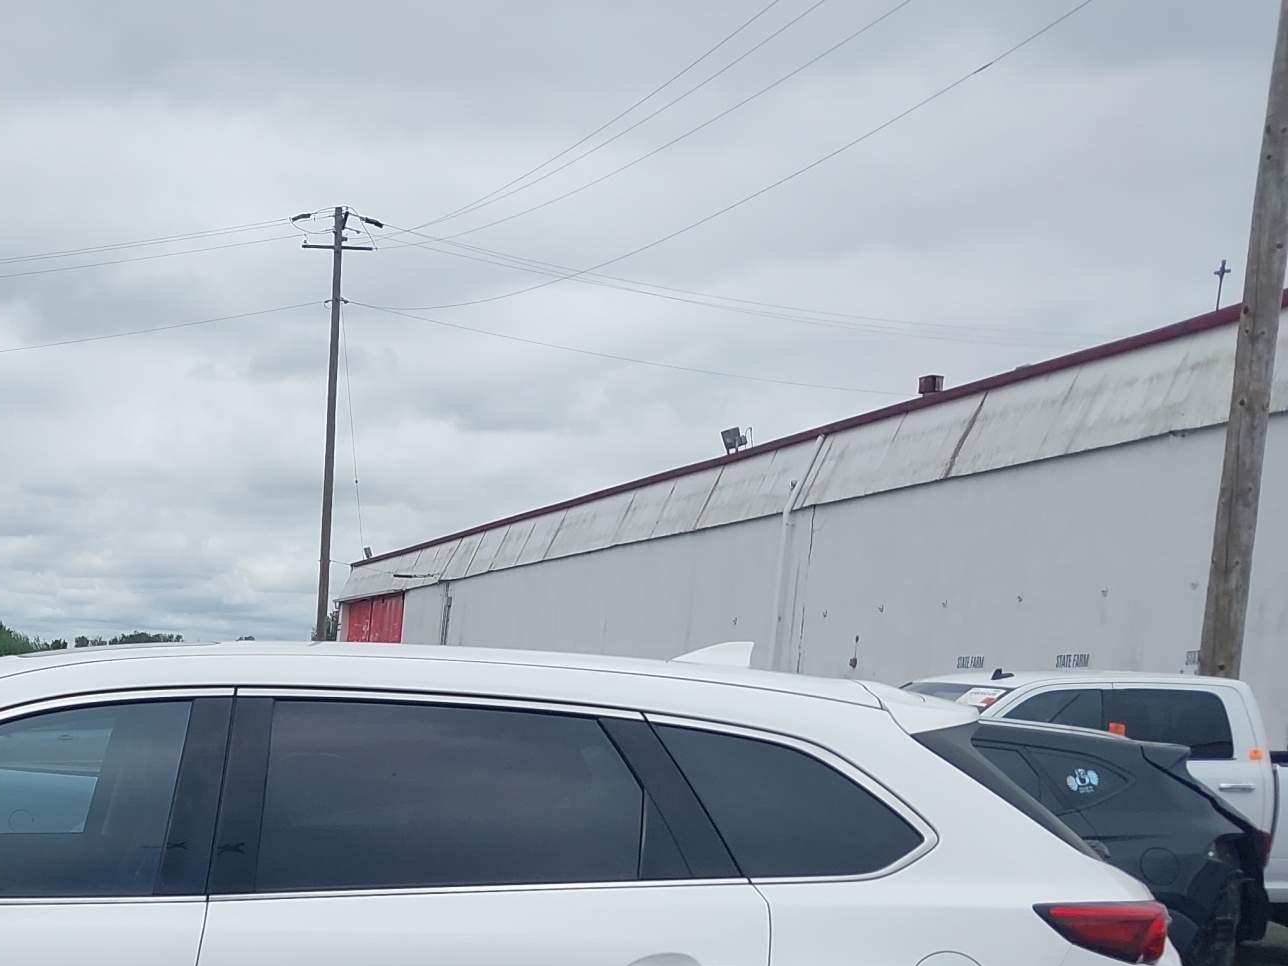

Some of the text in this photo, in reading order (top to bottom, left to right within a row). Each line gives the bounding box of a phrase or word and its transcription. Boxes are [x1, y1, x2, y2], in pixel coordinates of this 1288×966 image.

[956, 655, 985, 669] STATE FARM
[1055, 653, 1090, 668] STATE FARM
